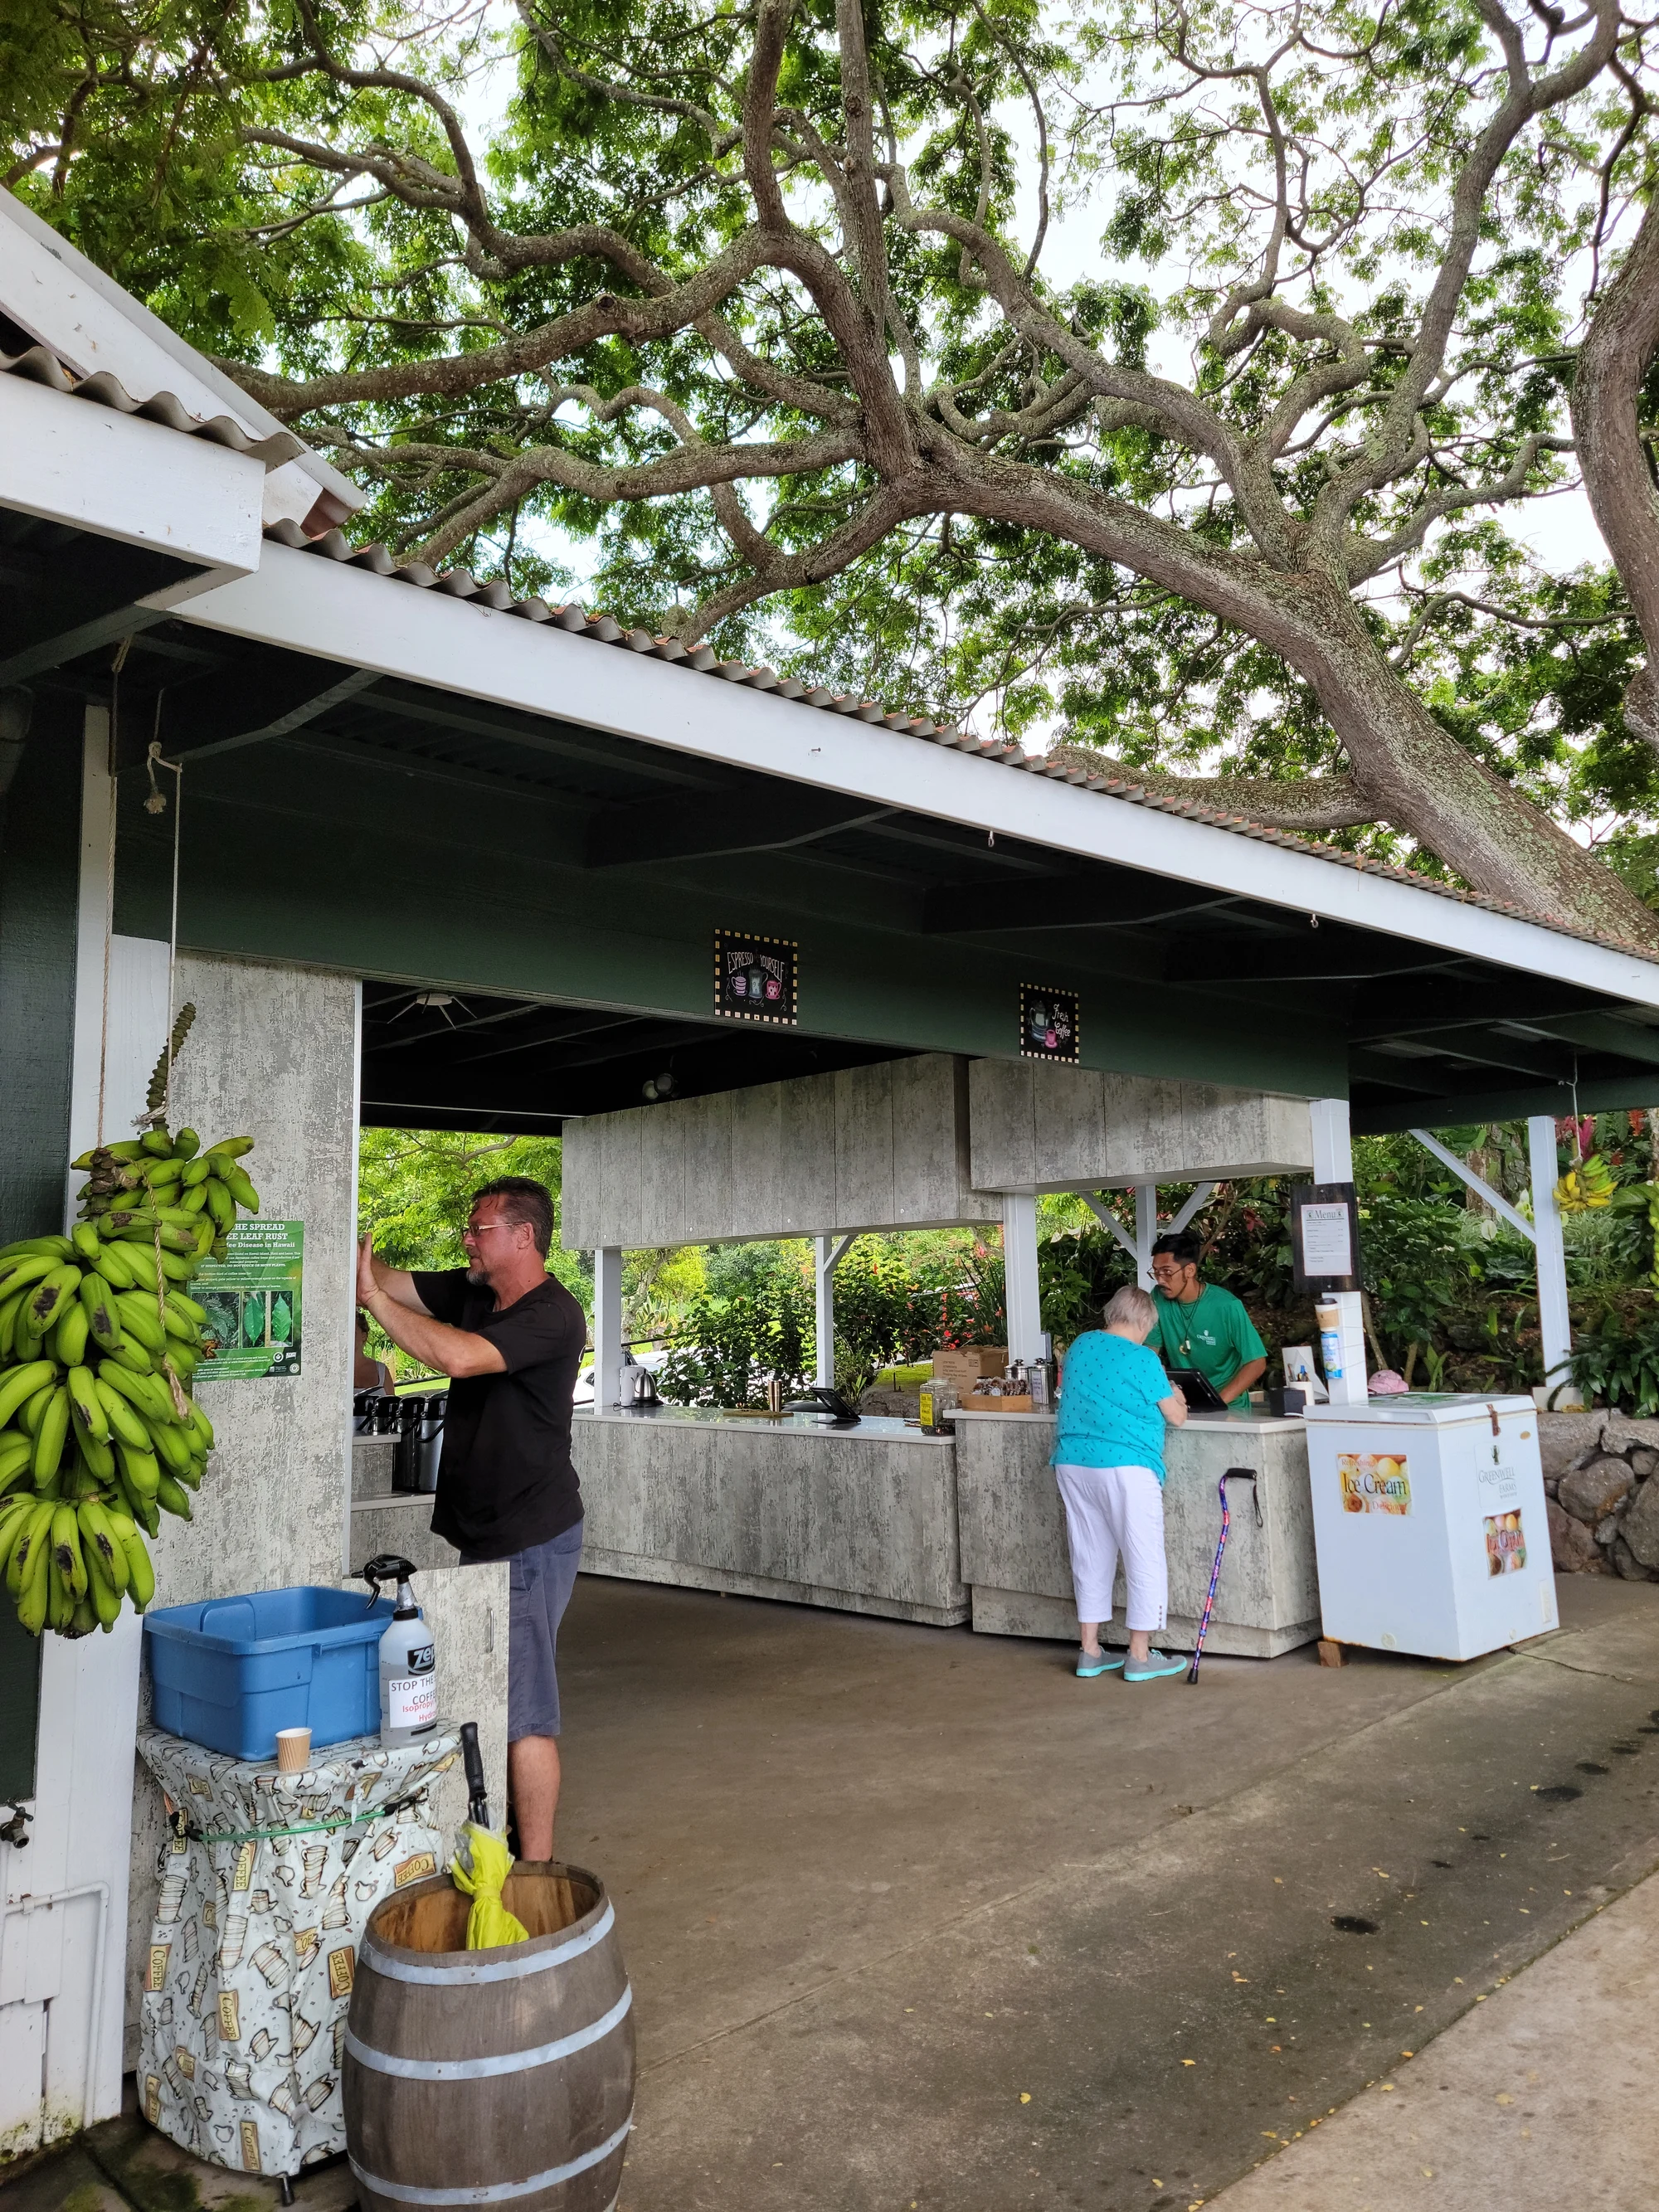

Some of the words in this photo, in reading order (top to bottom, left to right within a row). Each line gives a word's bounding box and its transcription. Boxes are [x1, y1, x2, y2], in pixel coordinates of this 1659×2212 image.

[727, 951, 754, 975] ESPRESSO
[760, 954, 785, 983] YOURSELF
[1054, 1021, 1071, 1039] Coffee
[1315, 1209, 1336, 1219] Menu
[1342, 1472, 1361, 1494] Ice
[1365, 1473, 1407, 1495] Cream
[392, 1680, 417, 1692] STOP
[420, 1675, 434, 1688] THE
[236, 1846, 250, 1888] COFFEE
[397, 1858, 429, 1884] COFFEE
[152, 1950, 166, 1988] COFFEE
[332, 1952, 350, 1991] COFFEE
[221, 1996, 236, 2039] COFFEE
[244, 2127, 259, 2168] COFFEE
